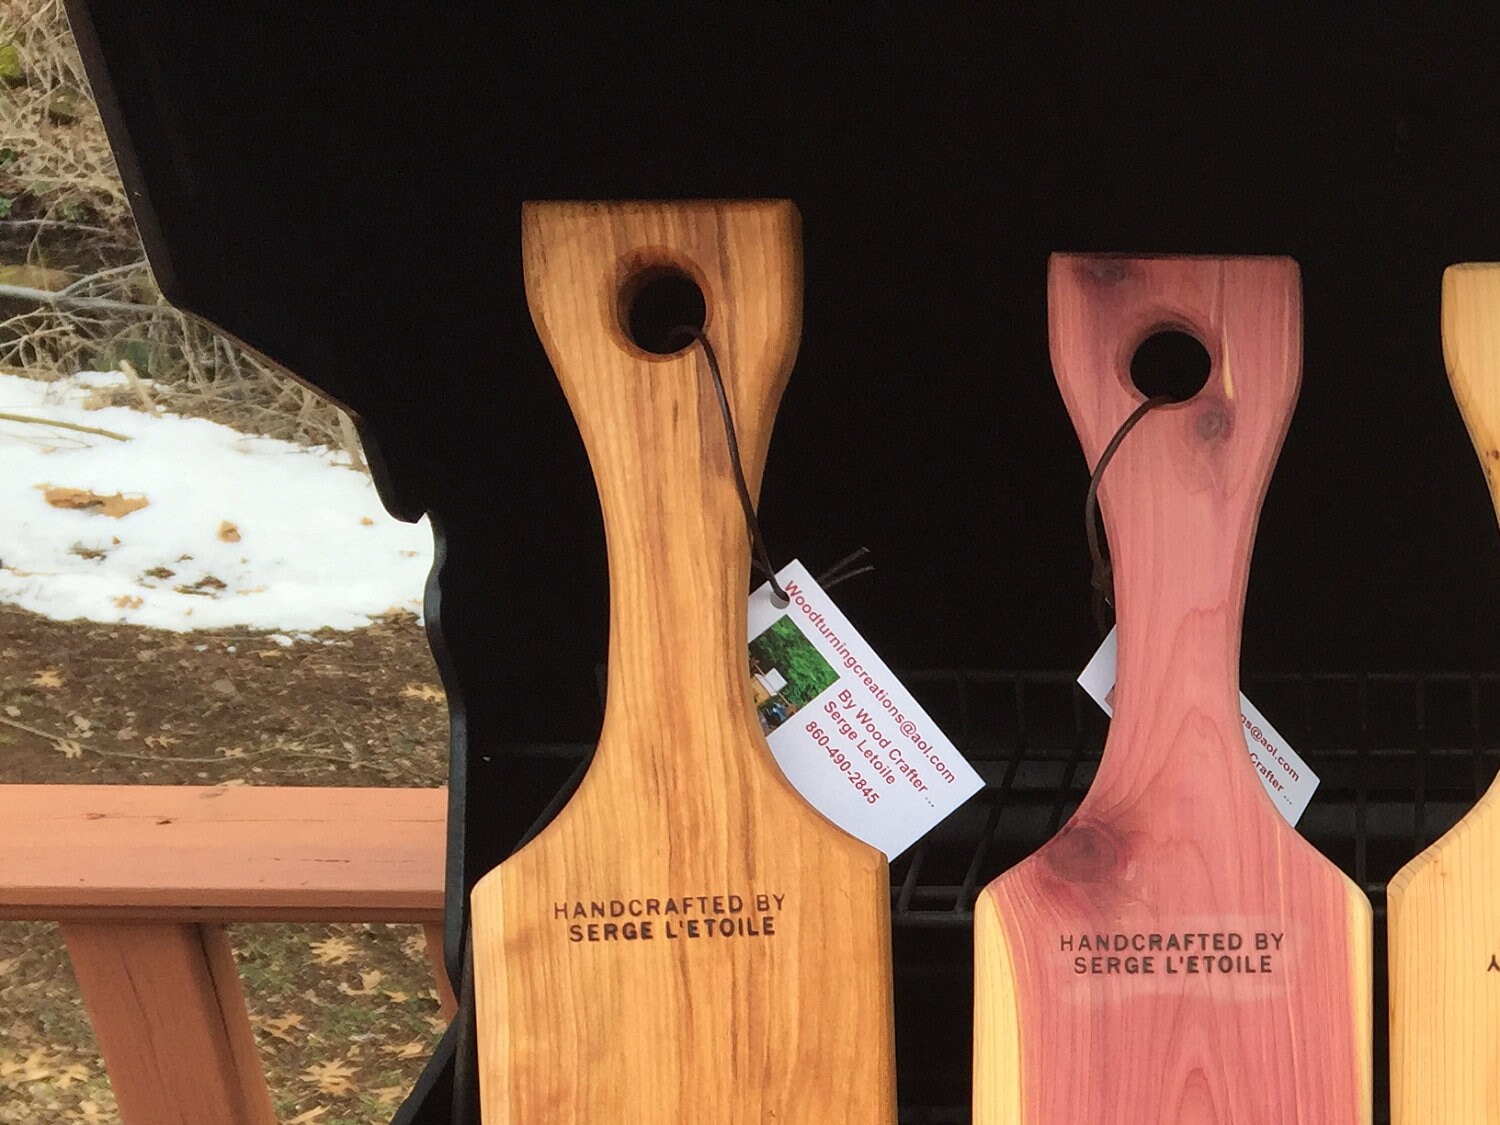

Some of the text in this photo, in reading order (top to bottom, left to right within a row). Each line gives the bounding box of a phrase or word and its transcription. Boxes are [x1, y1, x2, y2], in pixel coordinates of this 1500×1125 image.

[784, 580, 956, 784] Woodturningcreations@aol.com
[823, 700, 896, 786] Serge Letoile
[836, 688, 855, 710] By
[855, 709, 891, 750] Wood
[888, 748, 928, 793] Crafter
[804, 720, 880, 805] 860-490-2845
[1249, 752, 1285, 792] Crafter
[554, 893, 786, 919] HANDCRAFTED BY
[569, 916, 776, 942] SERGE L'ETOILE
[1060, 933, 1284, 951] HANDCRAFTED BY
[1074, 955, 1272, 974] SERGE L'ETOILE
